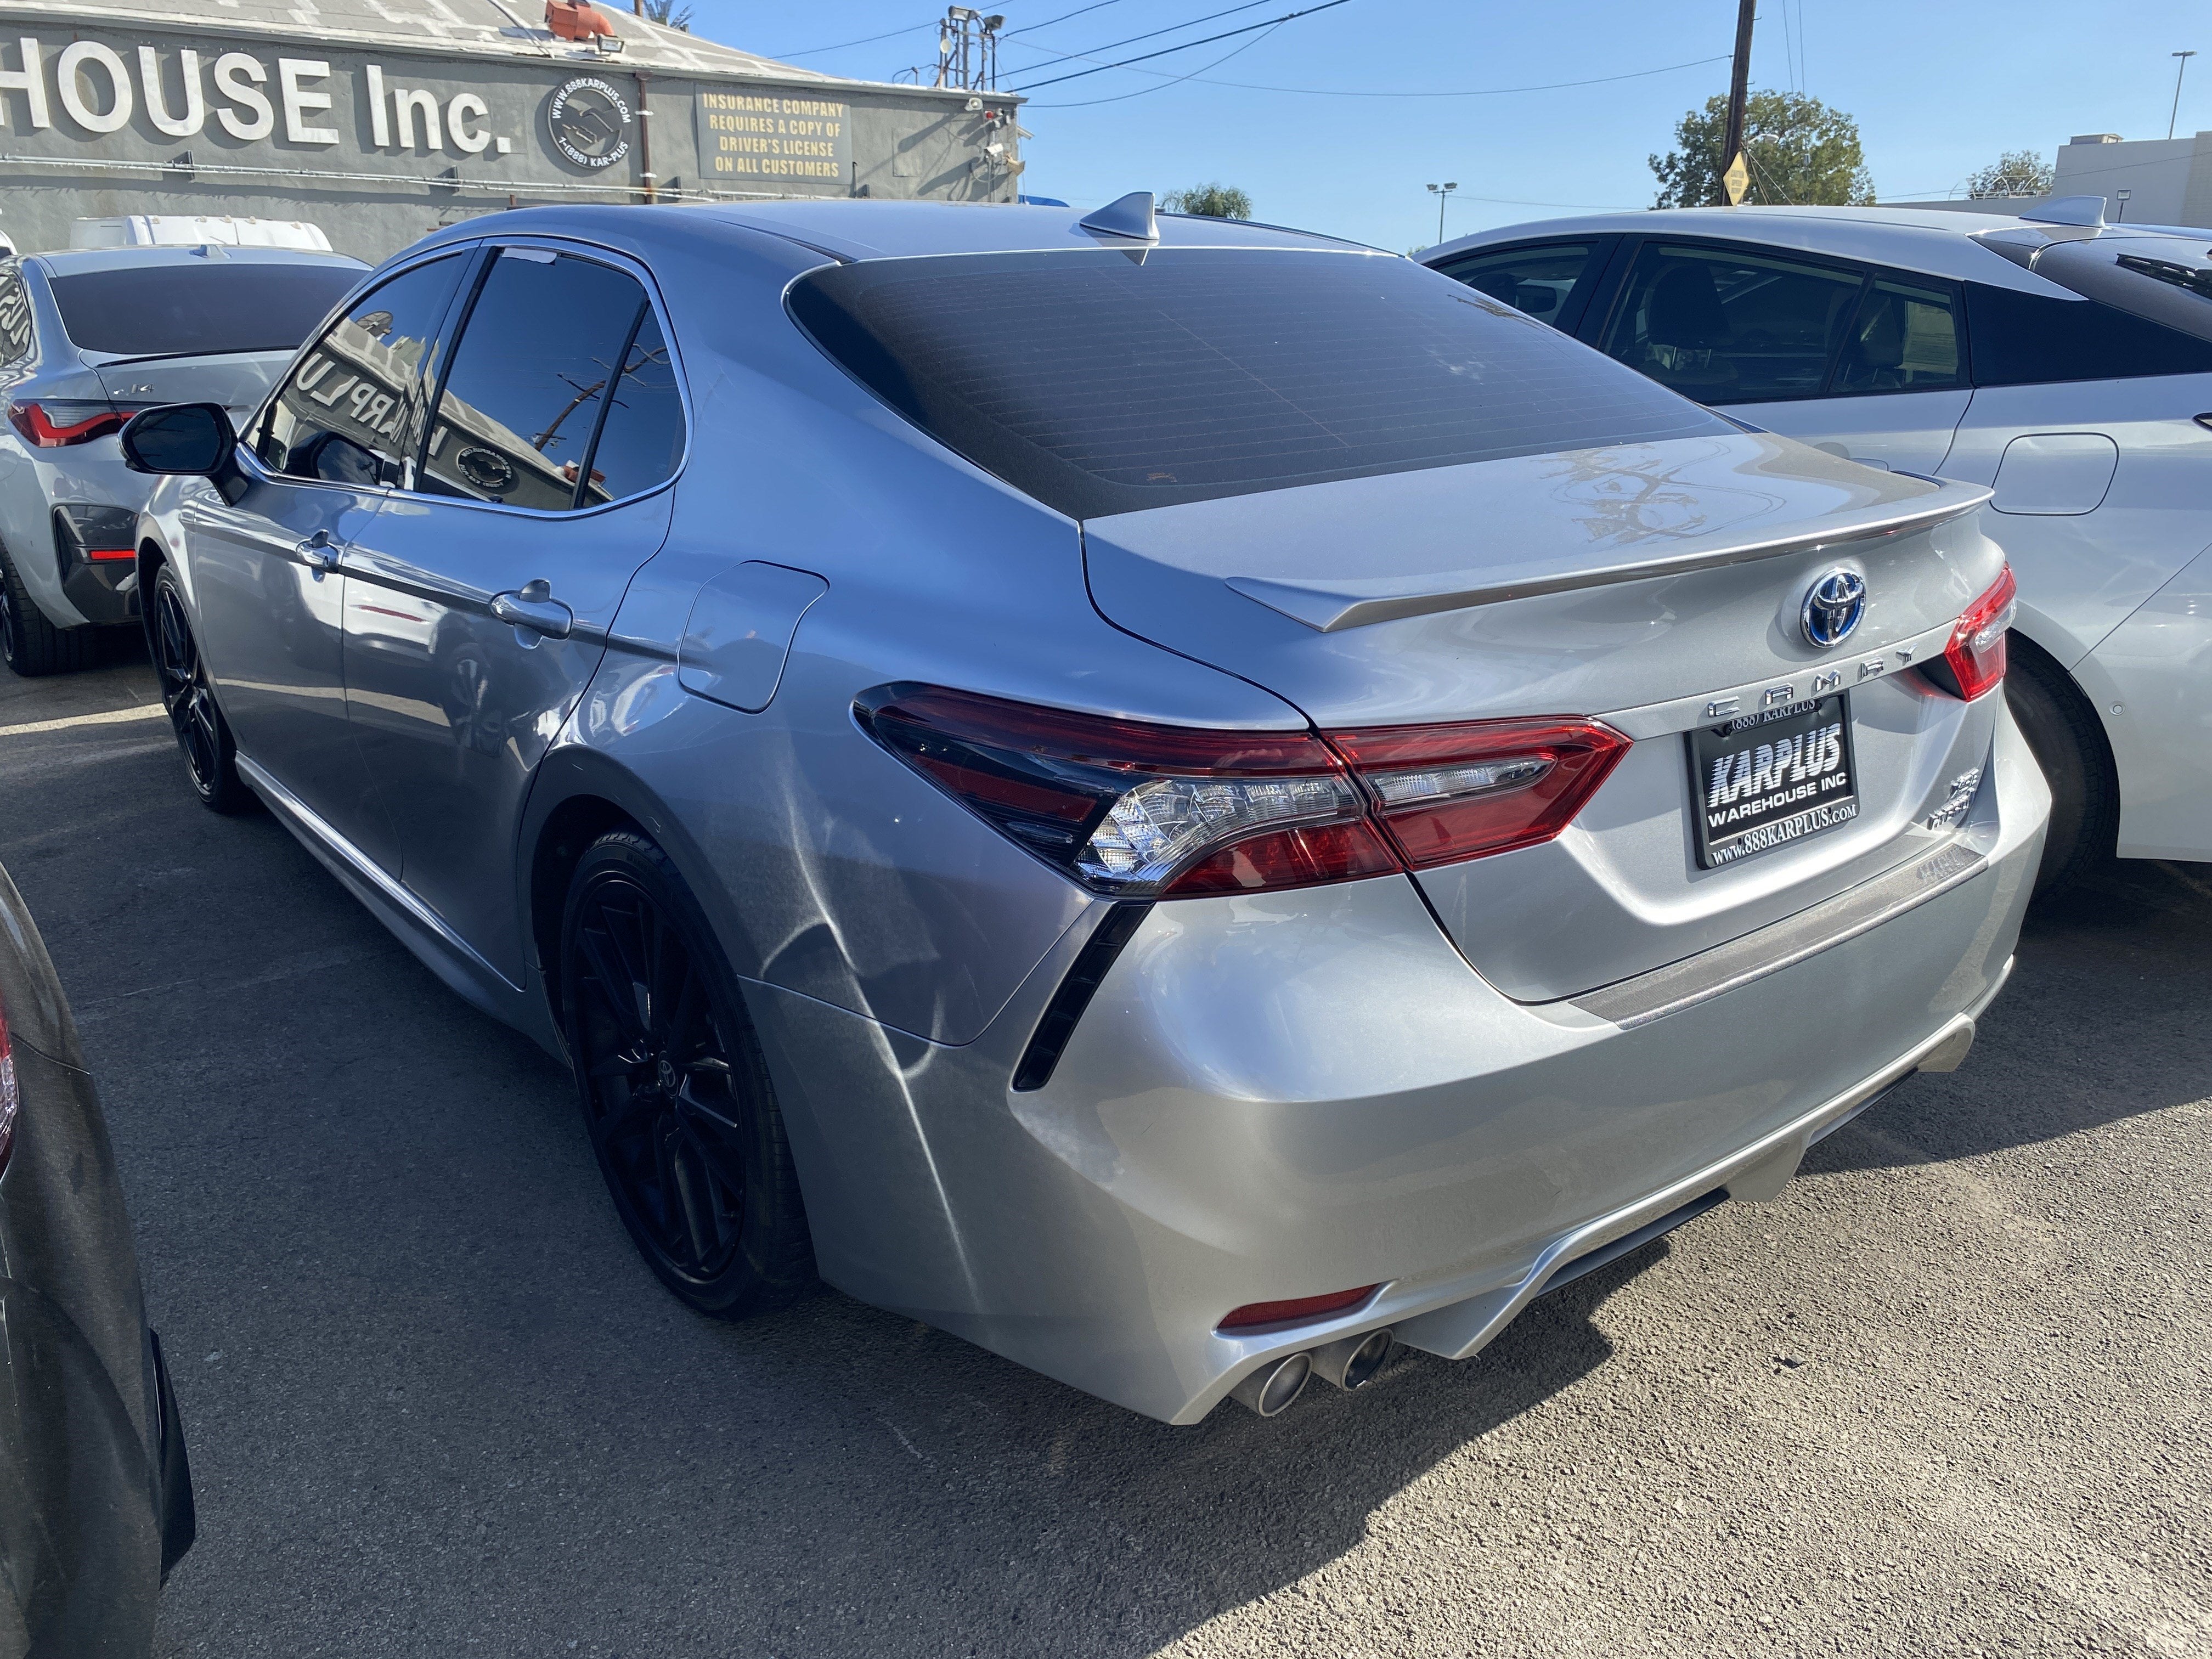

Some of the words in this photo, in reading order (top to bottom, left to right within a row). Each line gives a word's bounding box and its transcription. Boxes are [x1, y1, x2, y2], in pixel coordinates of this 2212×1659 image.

[0, 37, 339, 144] HOUSE
[366, 64, 511, 153] Inc.
[552, 78, 631, 123] WWW.888KARPLUS.COM
[703, 92, 780, 113] INSURANCE
[782, 99, 843, 117] COMPANY
[709, 114, 774, 133] REQUIRES
[778, 120, 786, 134] A
[789, 120, 822, 136] COPY
[826, 122, 840, 137] OF
[558, 137, 587, 165] 1-(888)
[590, 141, 629, 167] KAR-PLUS
[719, 136, 780, 154] DRIVER'S
[783, 140, 834, 157] LICENSE
[715, 156, 733, 172] ON
[737, 157, 759, 173] ALL
[761, 159, 839, 178] CUSTOMERS
[1707, 642, 1918, 718] CAMRY
[1762, 699, 1816, 723] KARPLUS
[1707, 723, 1841, 808] KARPLUS
[1708, 781, 1817, 828] WAREHOUSE
[1821, 772, 1847, 791] INC
